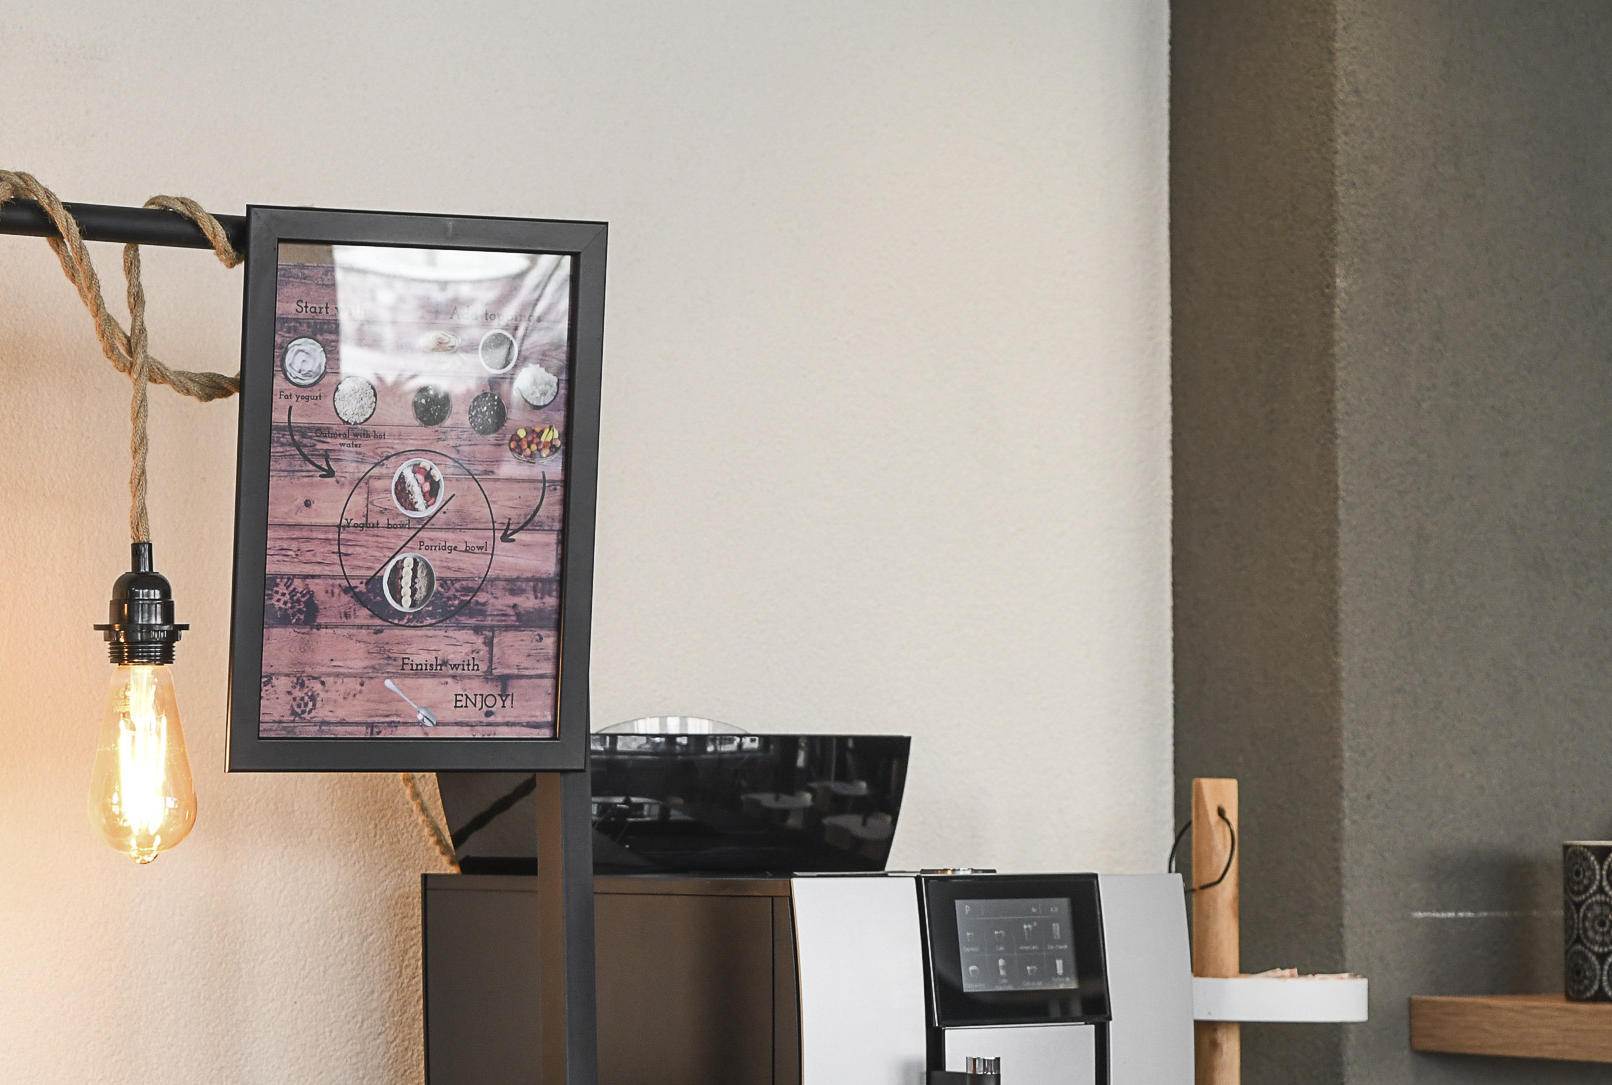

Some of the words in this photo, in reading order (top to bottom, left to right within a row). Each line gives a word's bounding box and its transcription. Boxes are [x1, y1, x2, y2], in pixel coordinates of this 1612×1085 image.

[295, 300, 330, 314] Start
[450, 306, 479, 320] Add
[483, 308, 543, 325] toppings
[278, 391, 293, 400] Fat
[295, 392, 322, 402] yogurt
[314, 429, 350, 438] Oatmeal
[353, 429, 371, 438] with
[373, 430, 386, 439] hot
[345, 518, 380, 531] Yogurt
[386, 518, 411, 529] bowl
[418, 541, 458, 553] Porridge
[465, 541, 488, 551] bowl
[400, 656, 443, 671] Finish
[448, 656, 480, 671] with
[453, 692, 515, 710] ENJOY!
